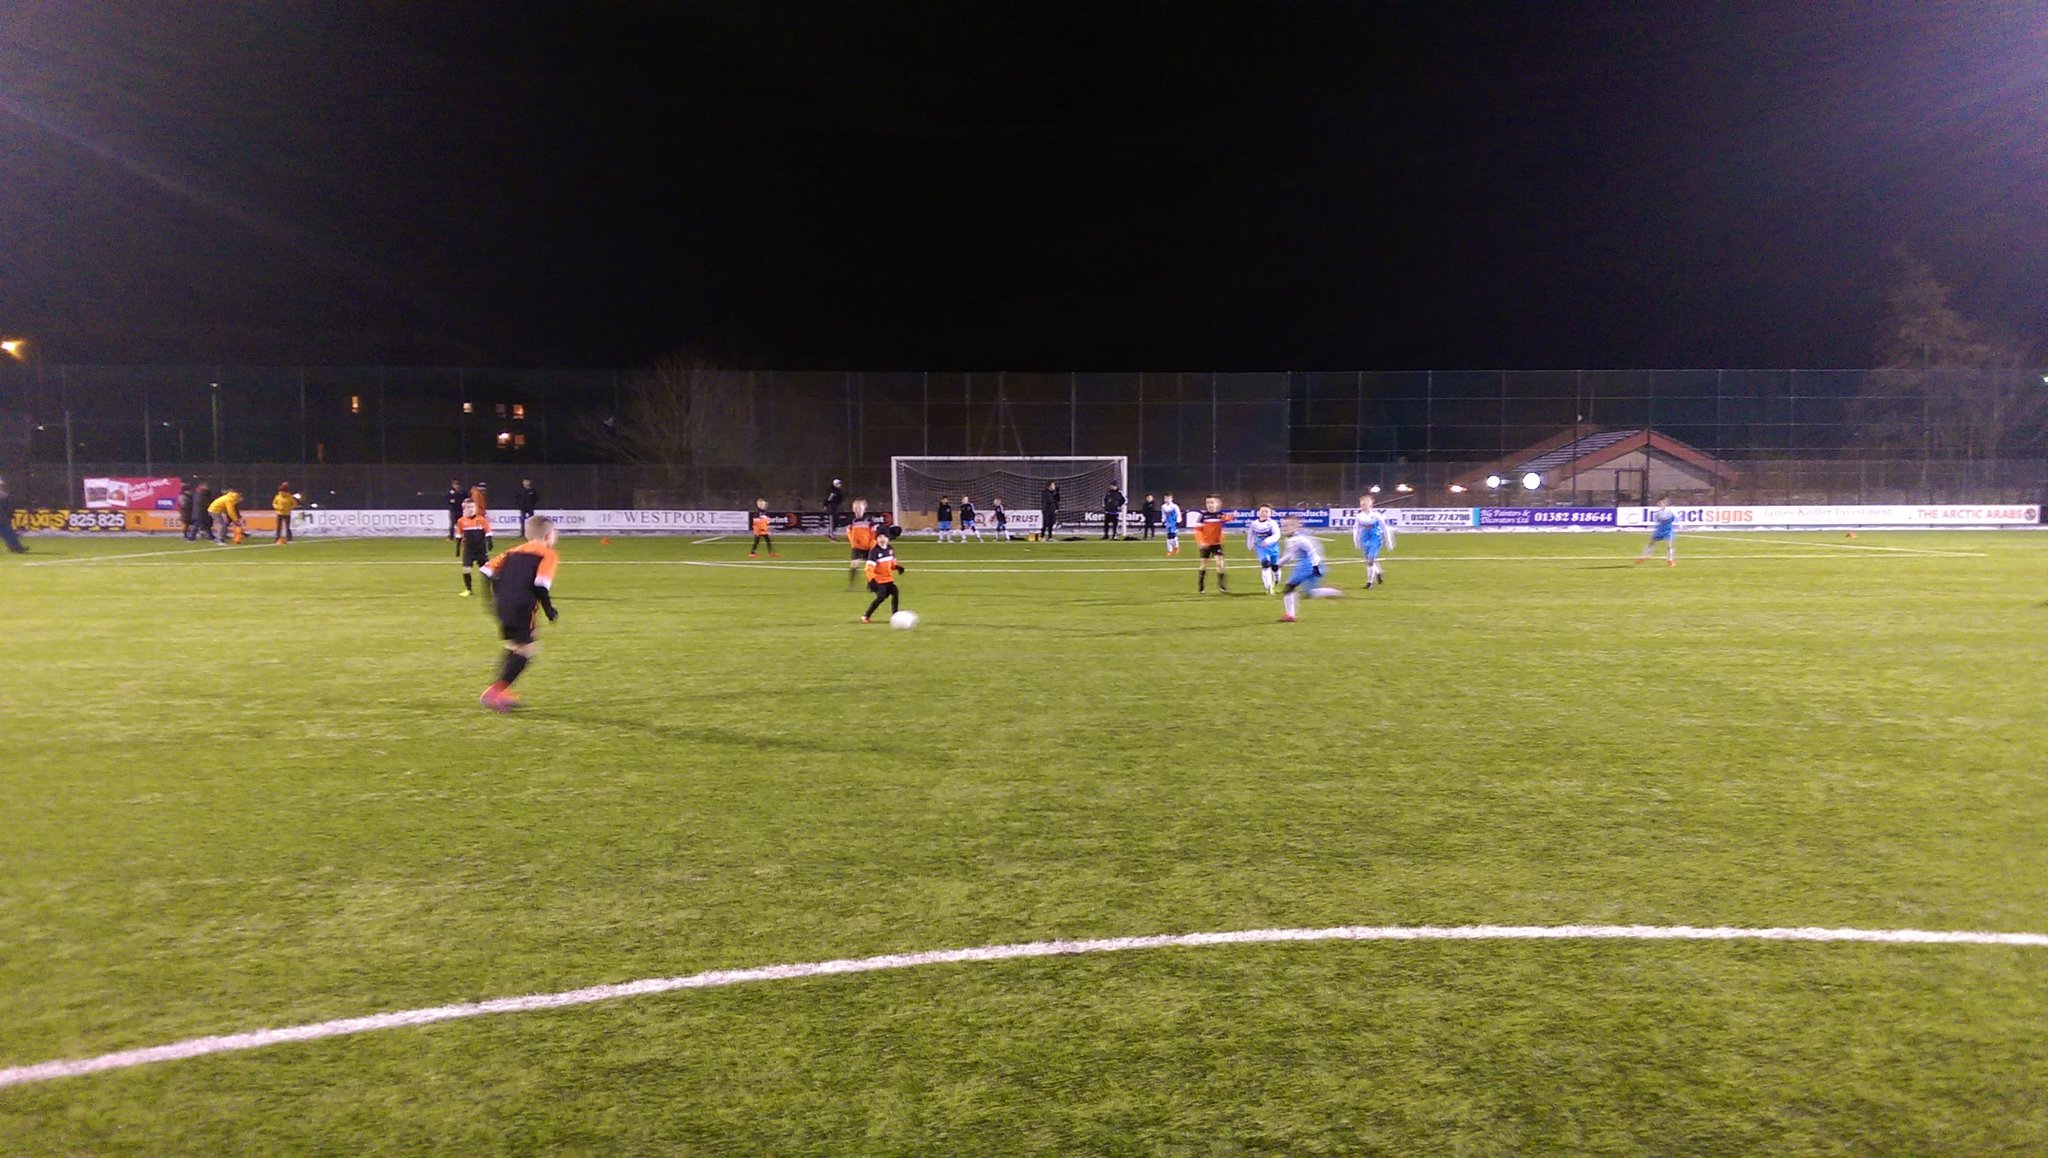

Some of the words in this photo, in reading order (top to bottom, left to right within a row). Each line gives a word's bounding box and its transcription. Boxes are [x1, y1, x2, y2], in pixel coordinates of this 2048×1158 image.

[69, 513, 96, 527] 825
[98, 513, 126, 527] 825
[318, 511, 434, 528] developments
[624, 511, 718, 524] WESTPORT
[1534, 511, 1569, 522] 01382
[1571, 511, 1613, 522] 818644
[1917, 509, 1939, 519] THE
[1942, 509, 1983, 519] ARCTIC
[1986, 509, 2023, 519] ARABS
